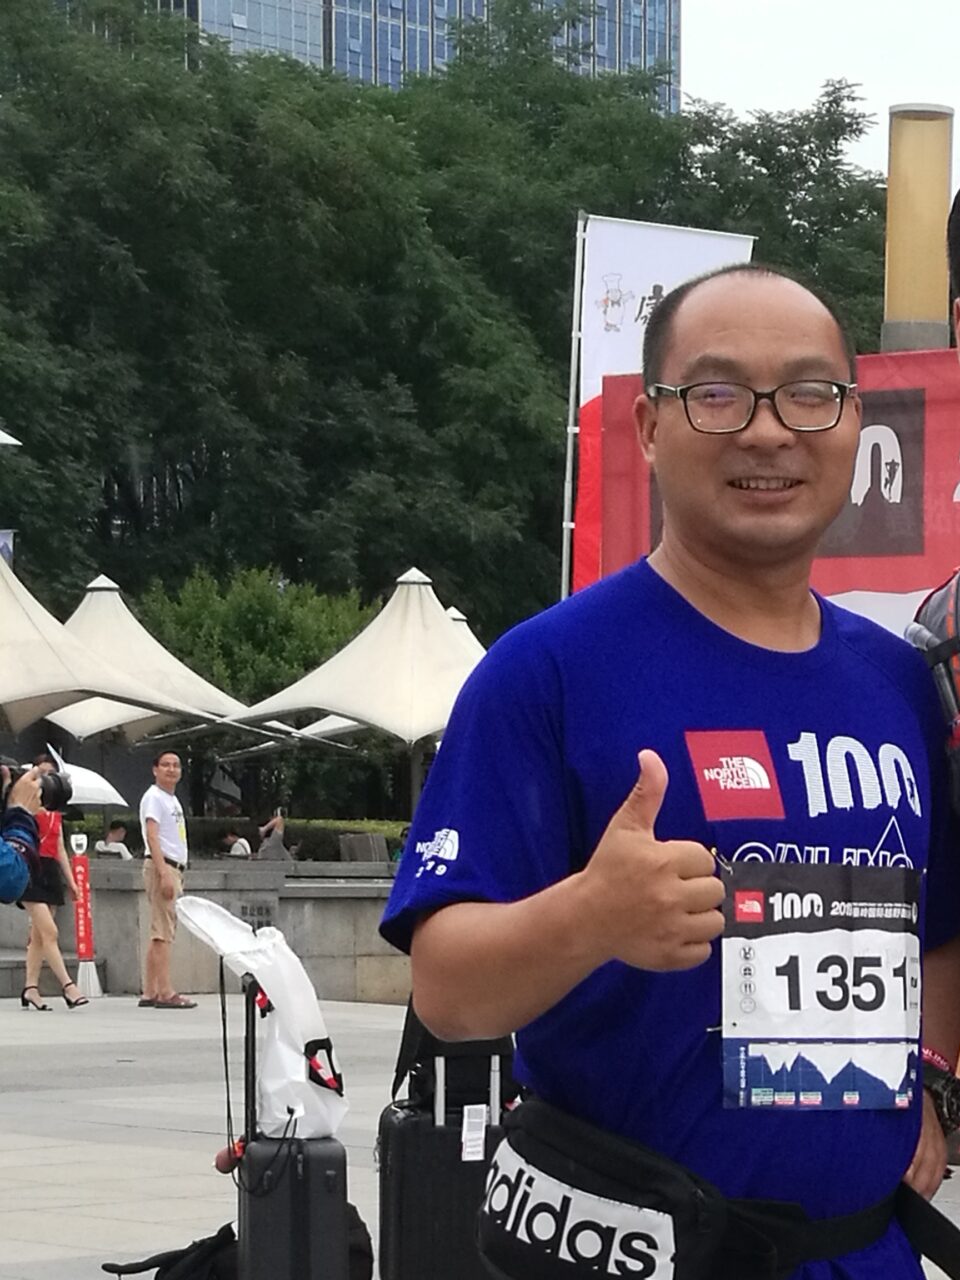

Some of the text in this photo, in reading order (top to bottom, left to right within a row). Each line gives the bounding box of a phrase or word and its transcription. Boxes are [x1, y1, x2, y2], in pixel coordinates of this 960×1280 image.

[719, 756, 744, 767] THE
[703, 767, 747, 781] NORTH
[719, 779, 750, 790] FACE
[787, 732, 922, 817] 100
[769, 892, 823, 921] 100
[775, 955, 907, 1012] 1351
